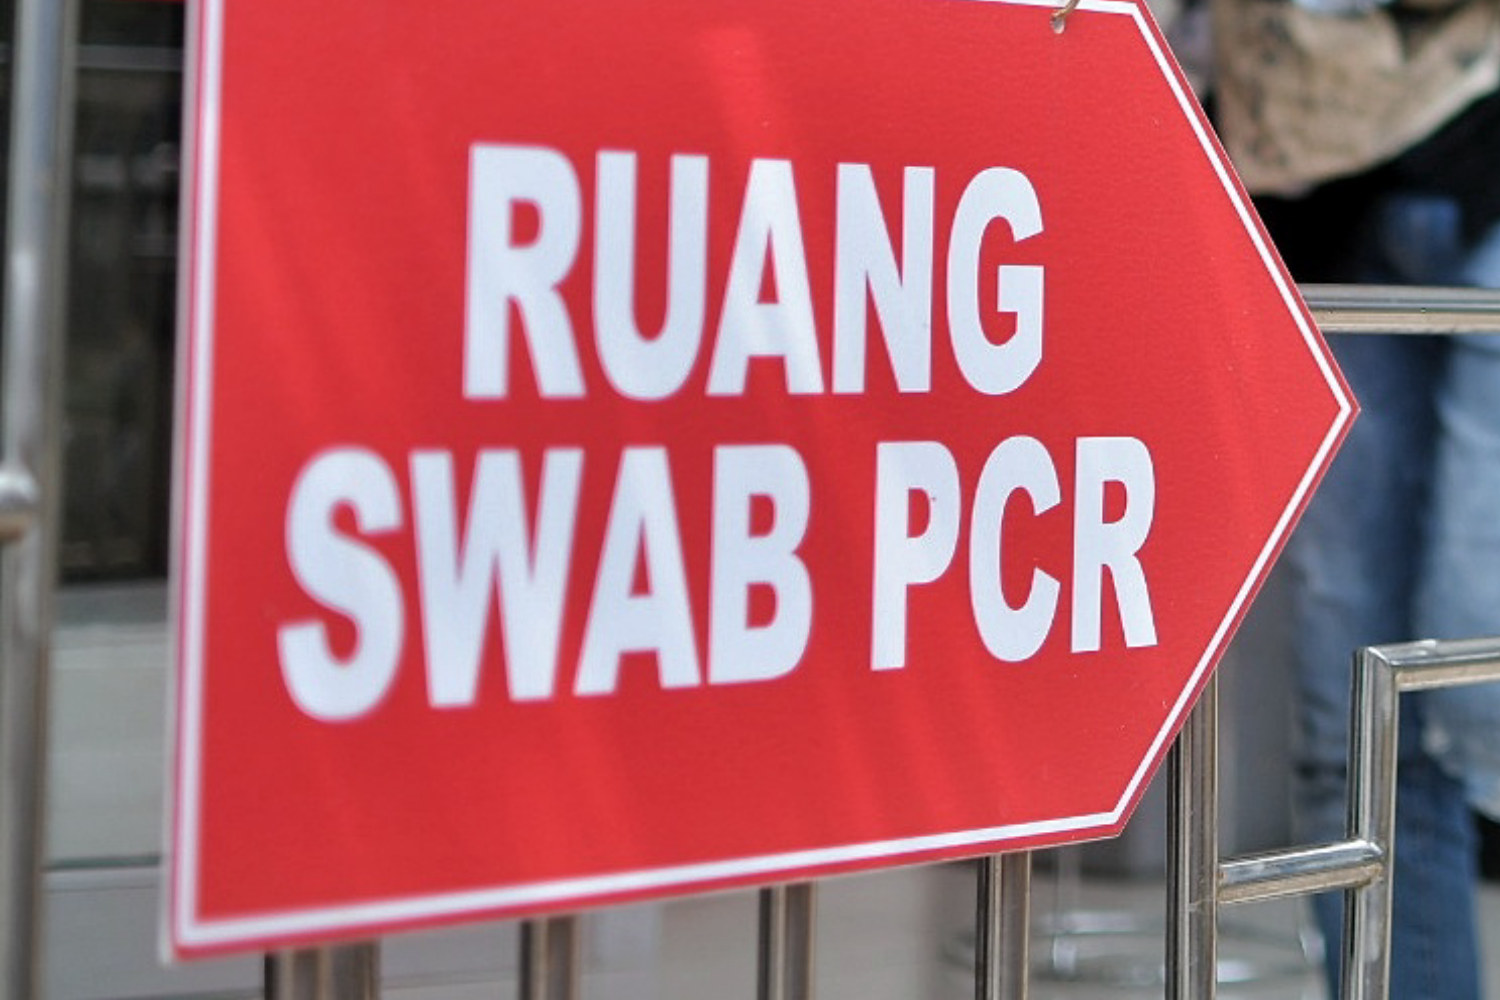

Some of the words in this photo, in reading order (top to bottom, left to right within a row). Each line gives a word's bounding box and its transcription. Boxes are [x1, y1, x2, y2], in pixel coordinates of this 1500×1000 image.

[463, 142, 1046, 401] RUANG
[277, 445, 814, 721] SWAB
[870, 434, 1159, 672] PCR
